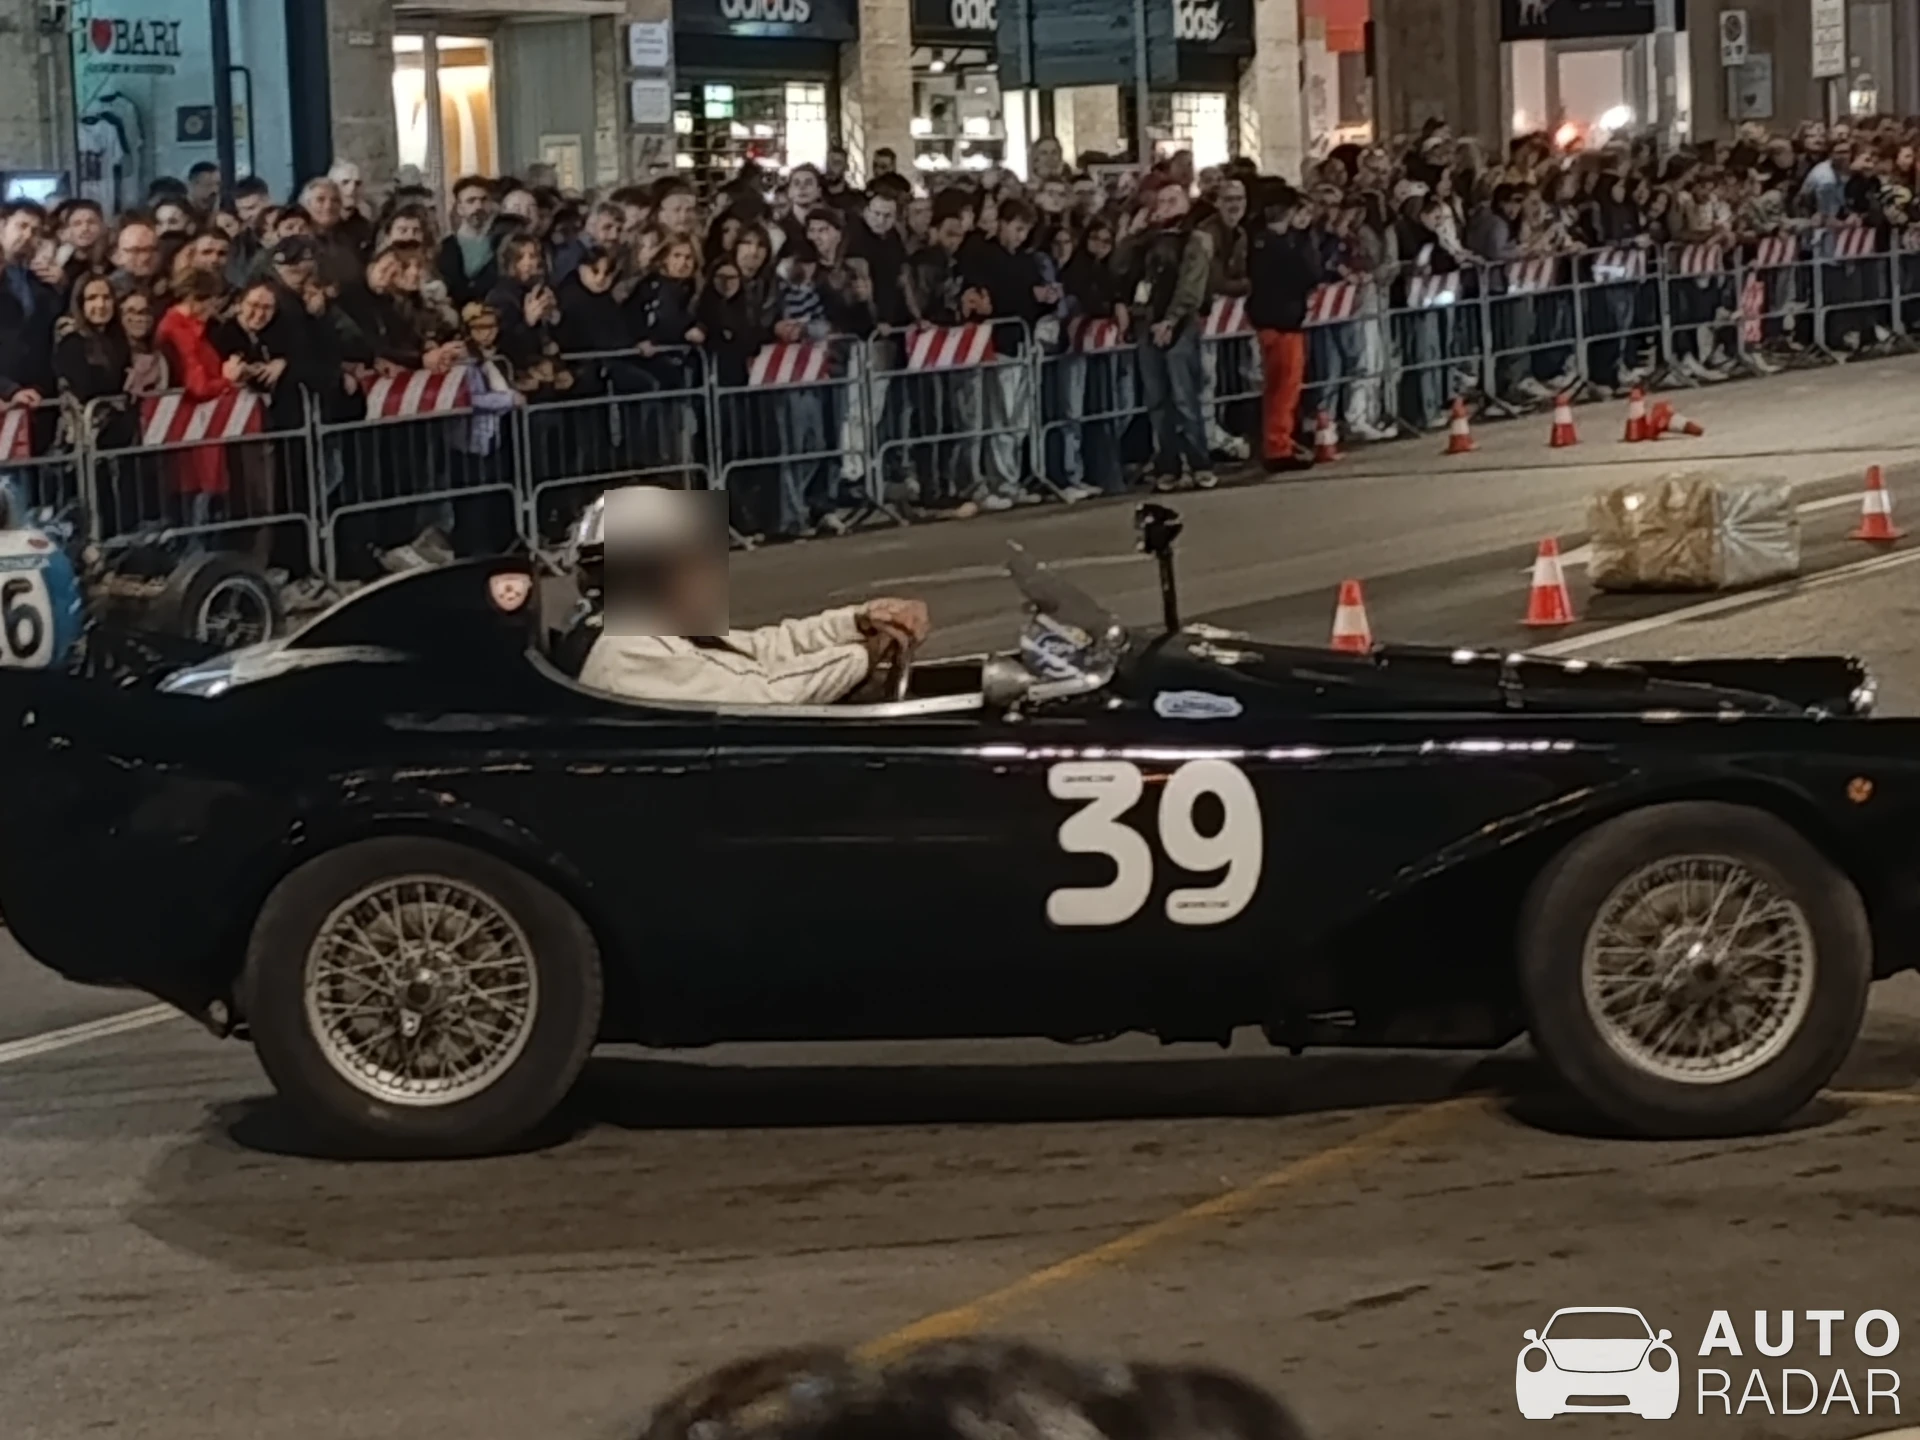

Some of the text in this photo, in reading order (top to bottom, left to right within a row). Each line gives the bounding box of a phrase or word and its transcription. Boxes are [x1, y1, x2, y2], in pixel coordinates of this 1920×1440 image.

[720, 0, 811, 23] adidas
[951, 0, 998, 31] adi
[113, 19, 182, 57] BARI
[0, 577, 44, 659] 6
[1048, 760, 1262, 926] 39
